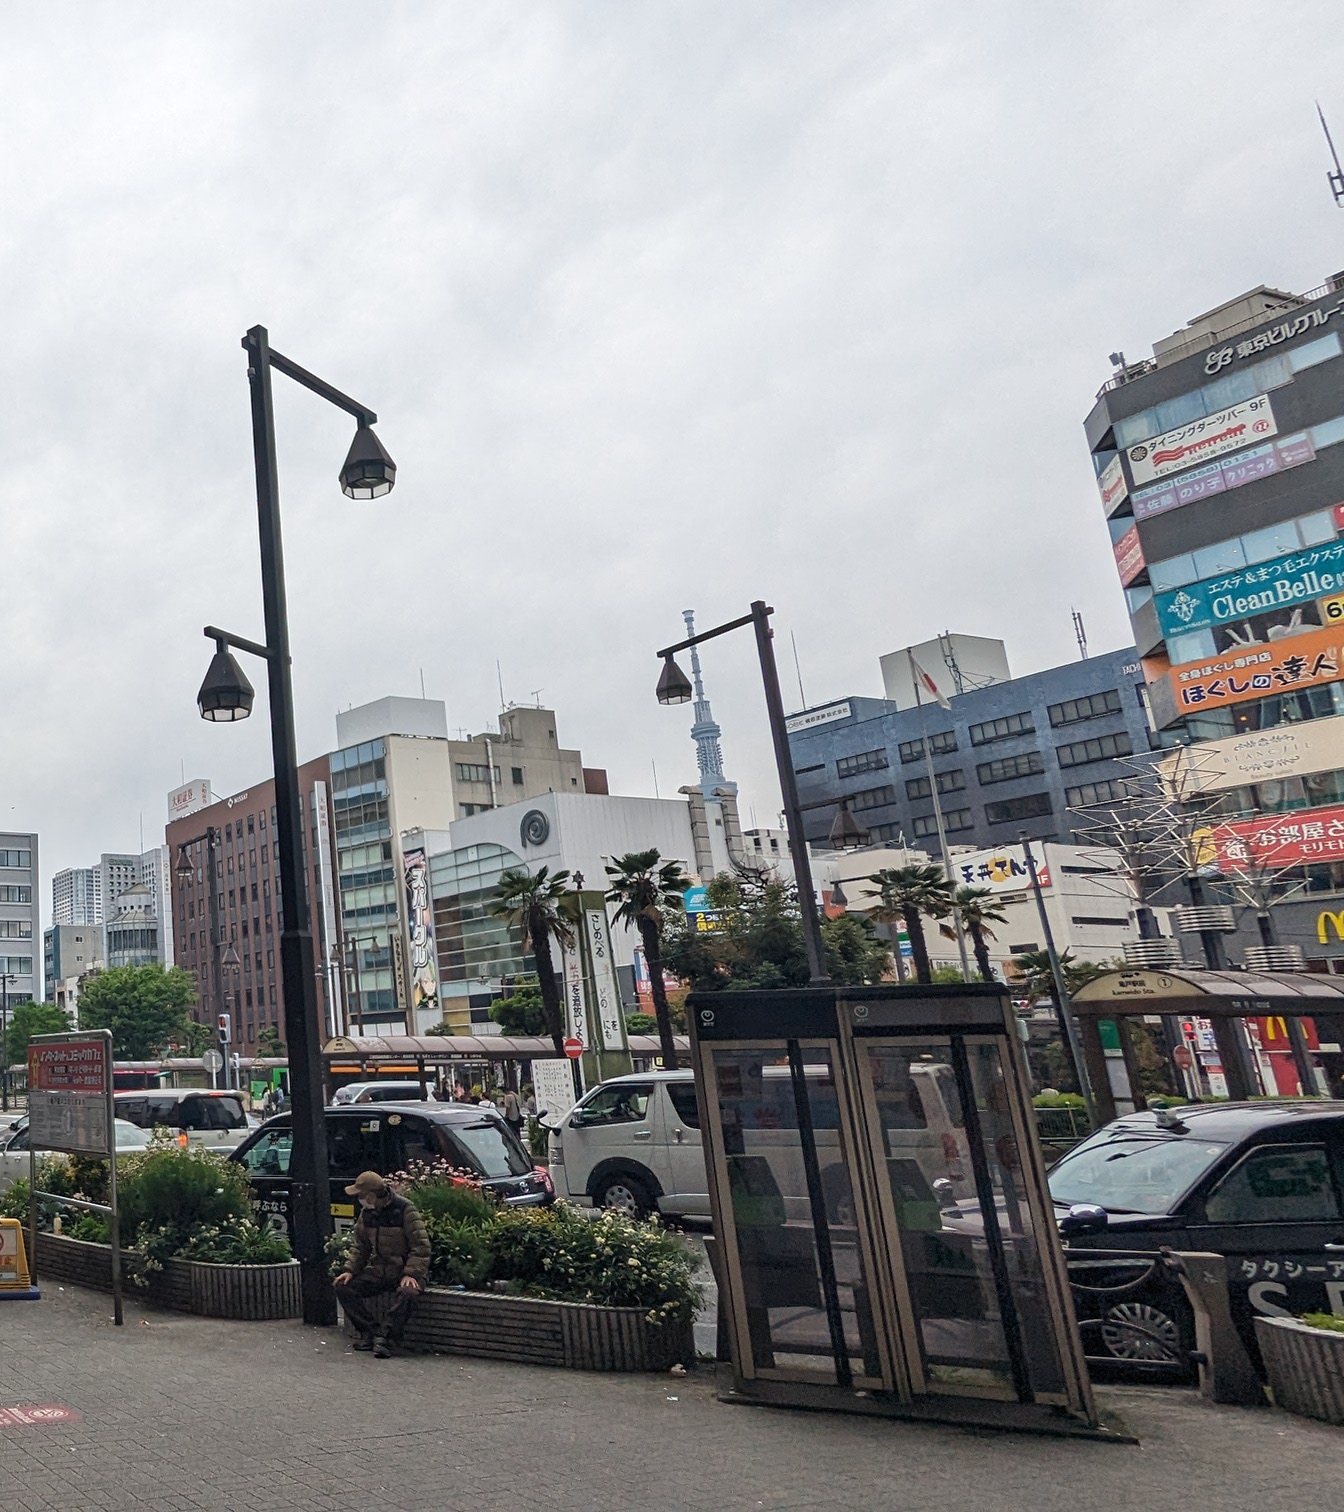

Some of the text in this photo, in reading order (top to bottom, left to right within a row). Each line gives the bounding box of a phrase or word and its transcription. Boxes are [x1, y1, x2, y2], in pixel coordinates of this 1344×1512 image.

[1149, 409, 1246, 452] ダイニングダーツバー
[1249, 398, 1267, 413] 9F
[1178, 651, 1273, 682] 全身ほぐし専門店
[1181, 652, 1338, 706] ほぐしの達人
